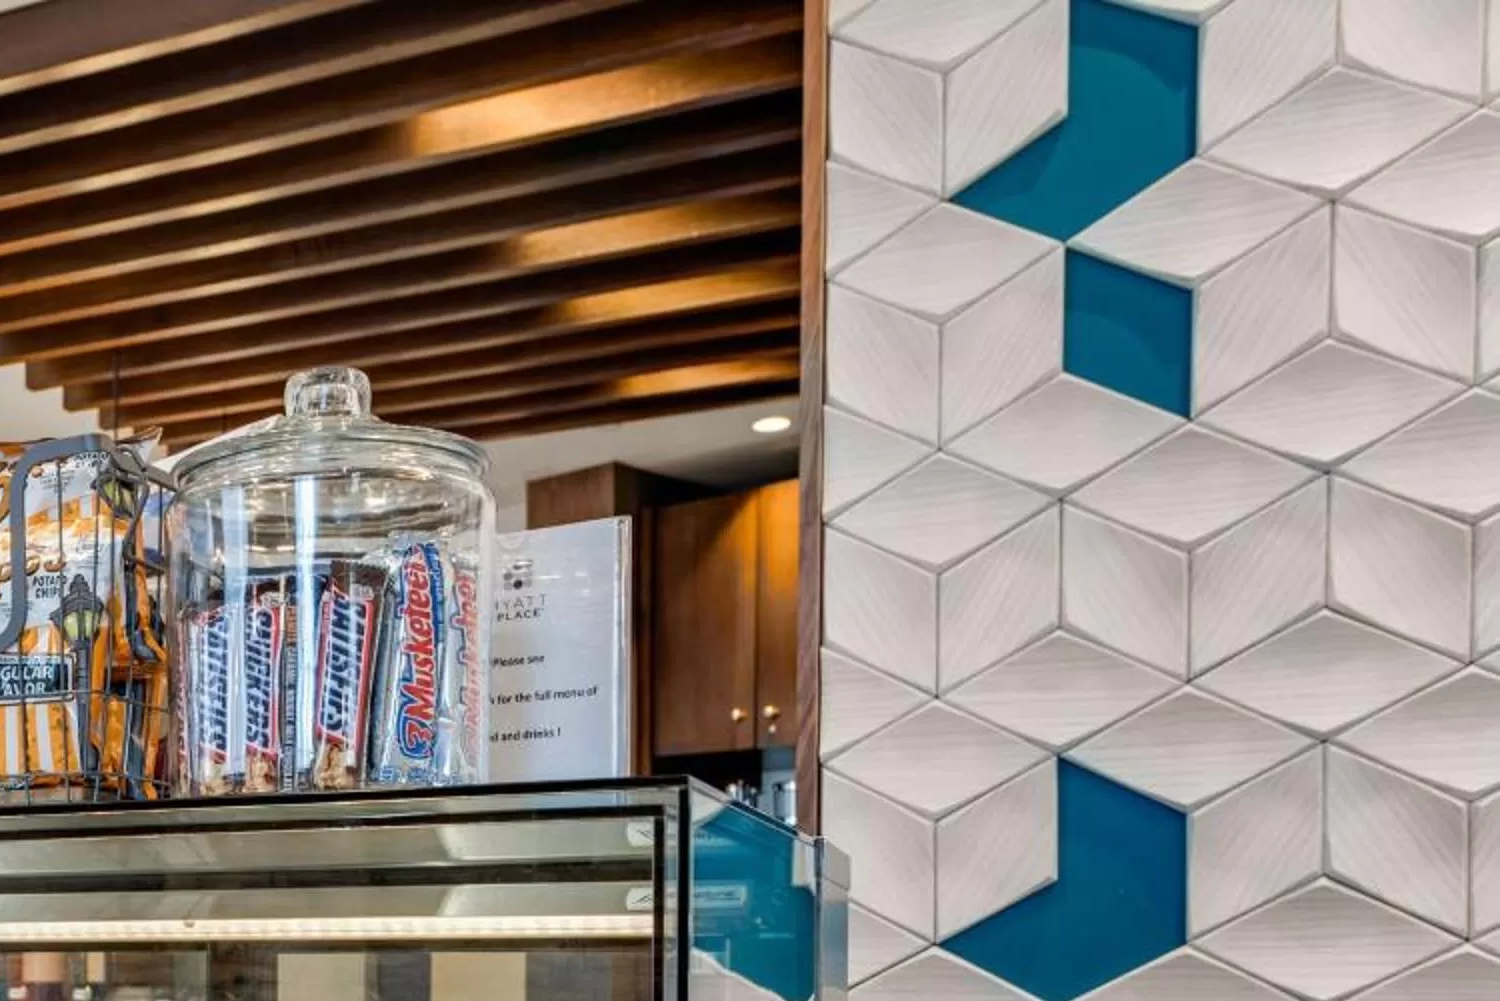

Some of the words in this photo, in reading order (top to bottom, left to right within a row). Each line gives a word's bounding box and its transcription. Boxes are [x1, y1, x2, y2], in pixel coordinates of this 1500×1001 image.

[496, 607, 545, 622] PLACE
[497, 694, 512, 705] for
[515, 692, 532, 703] the
